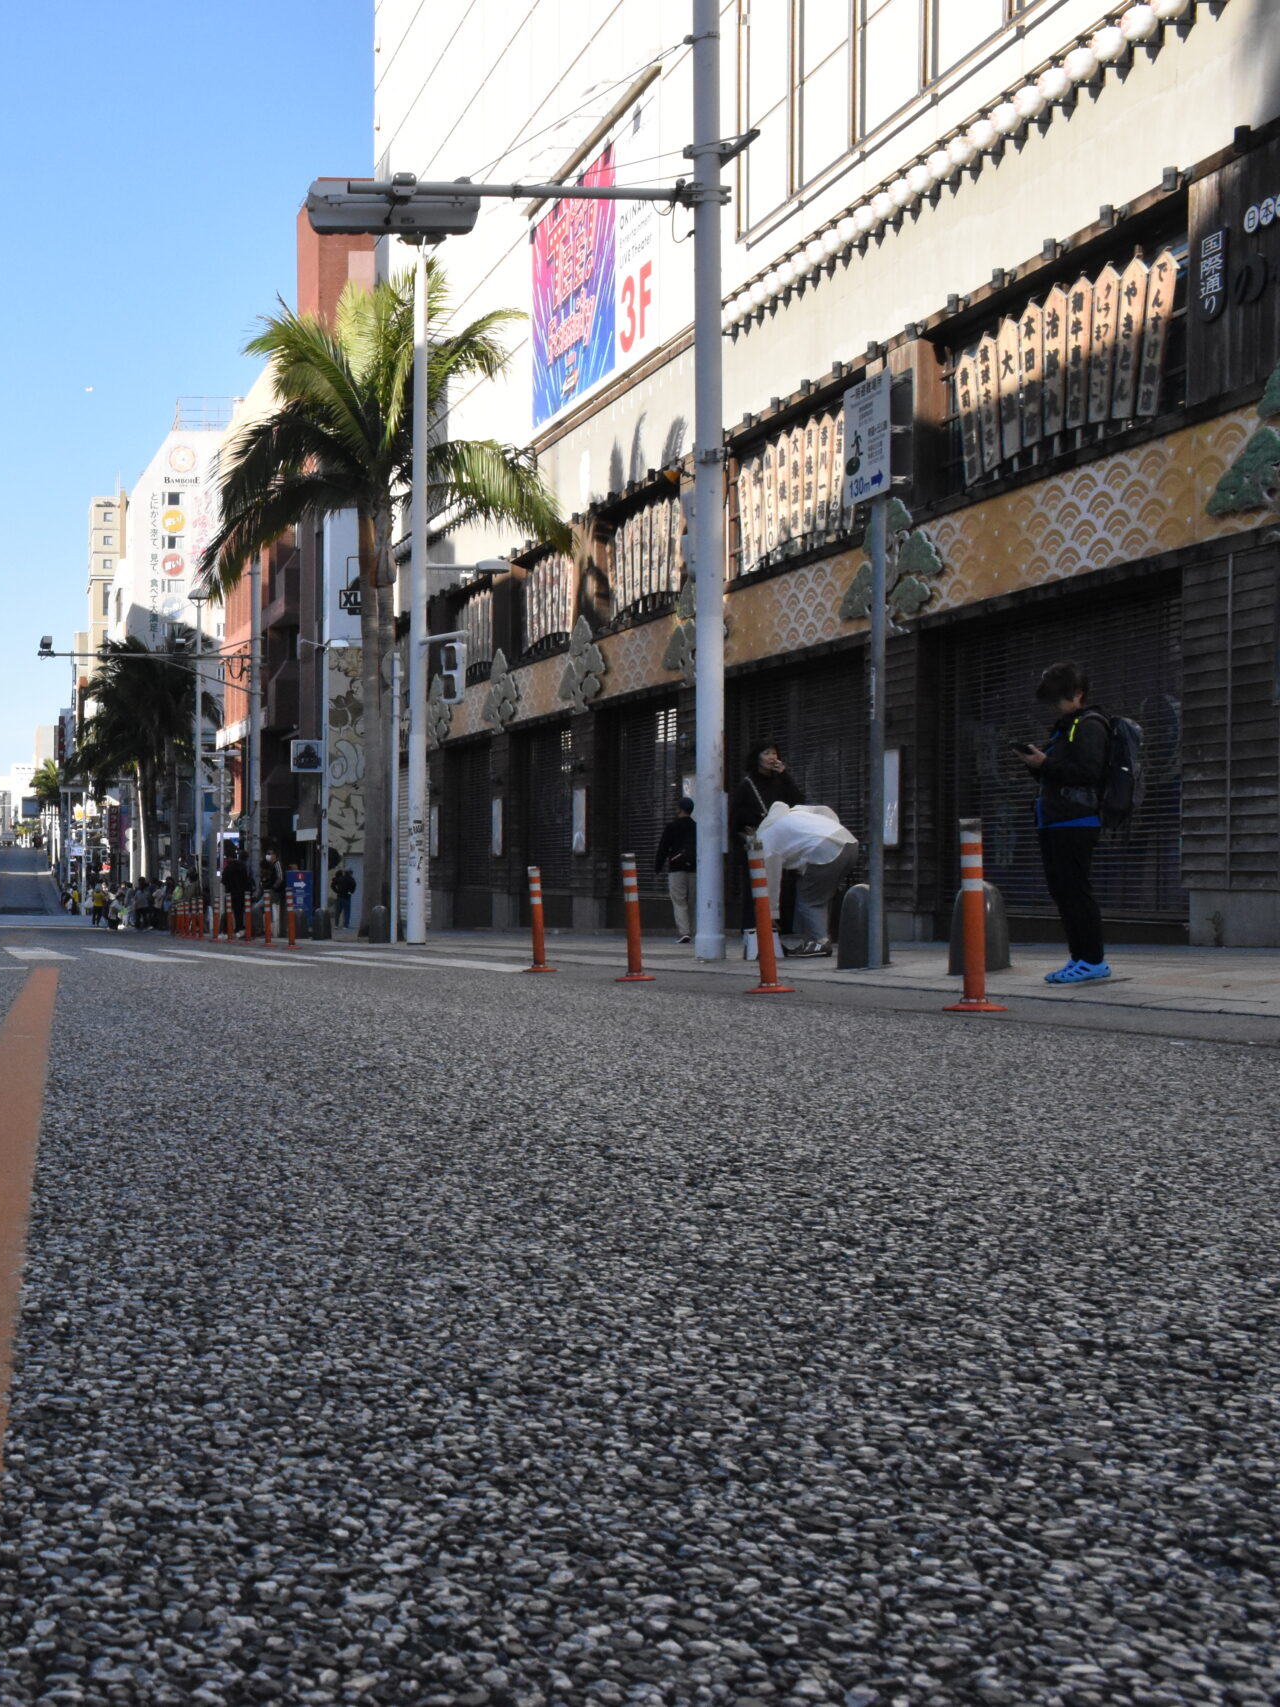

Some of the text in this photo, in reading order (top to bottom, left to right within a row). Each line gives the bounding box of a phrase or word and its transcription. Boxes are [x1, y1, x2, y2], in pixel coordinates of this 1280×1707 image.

[1247, 200, 1280, 229] 日本
[620, 259, 653, 353] 3F
[1200, 230, 1223, 314] 国際通り
[765, 454, 774, 547] MUCHO
[849, 476, 871, 498] 130m
